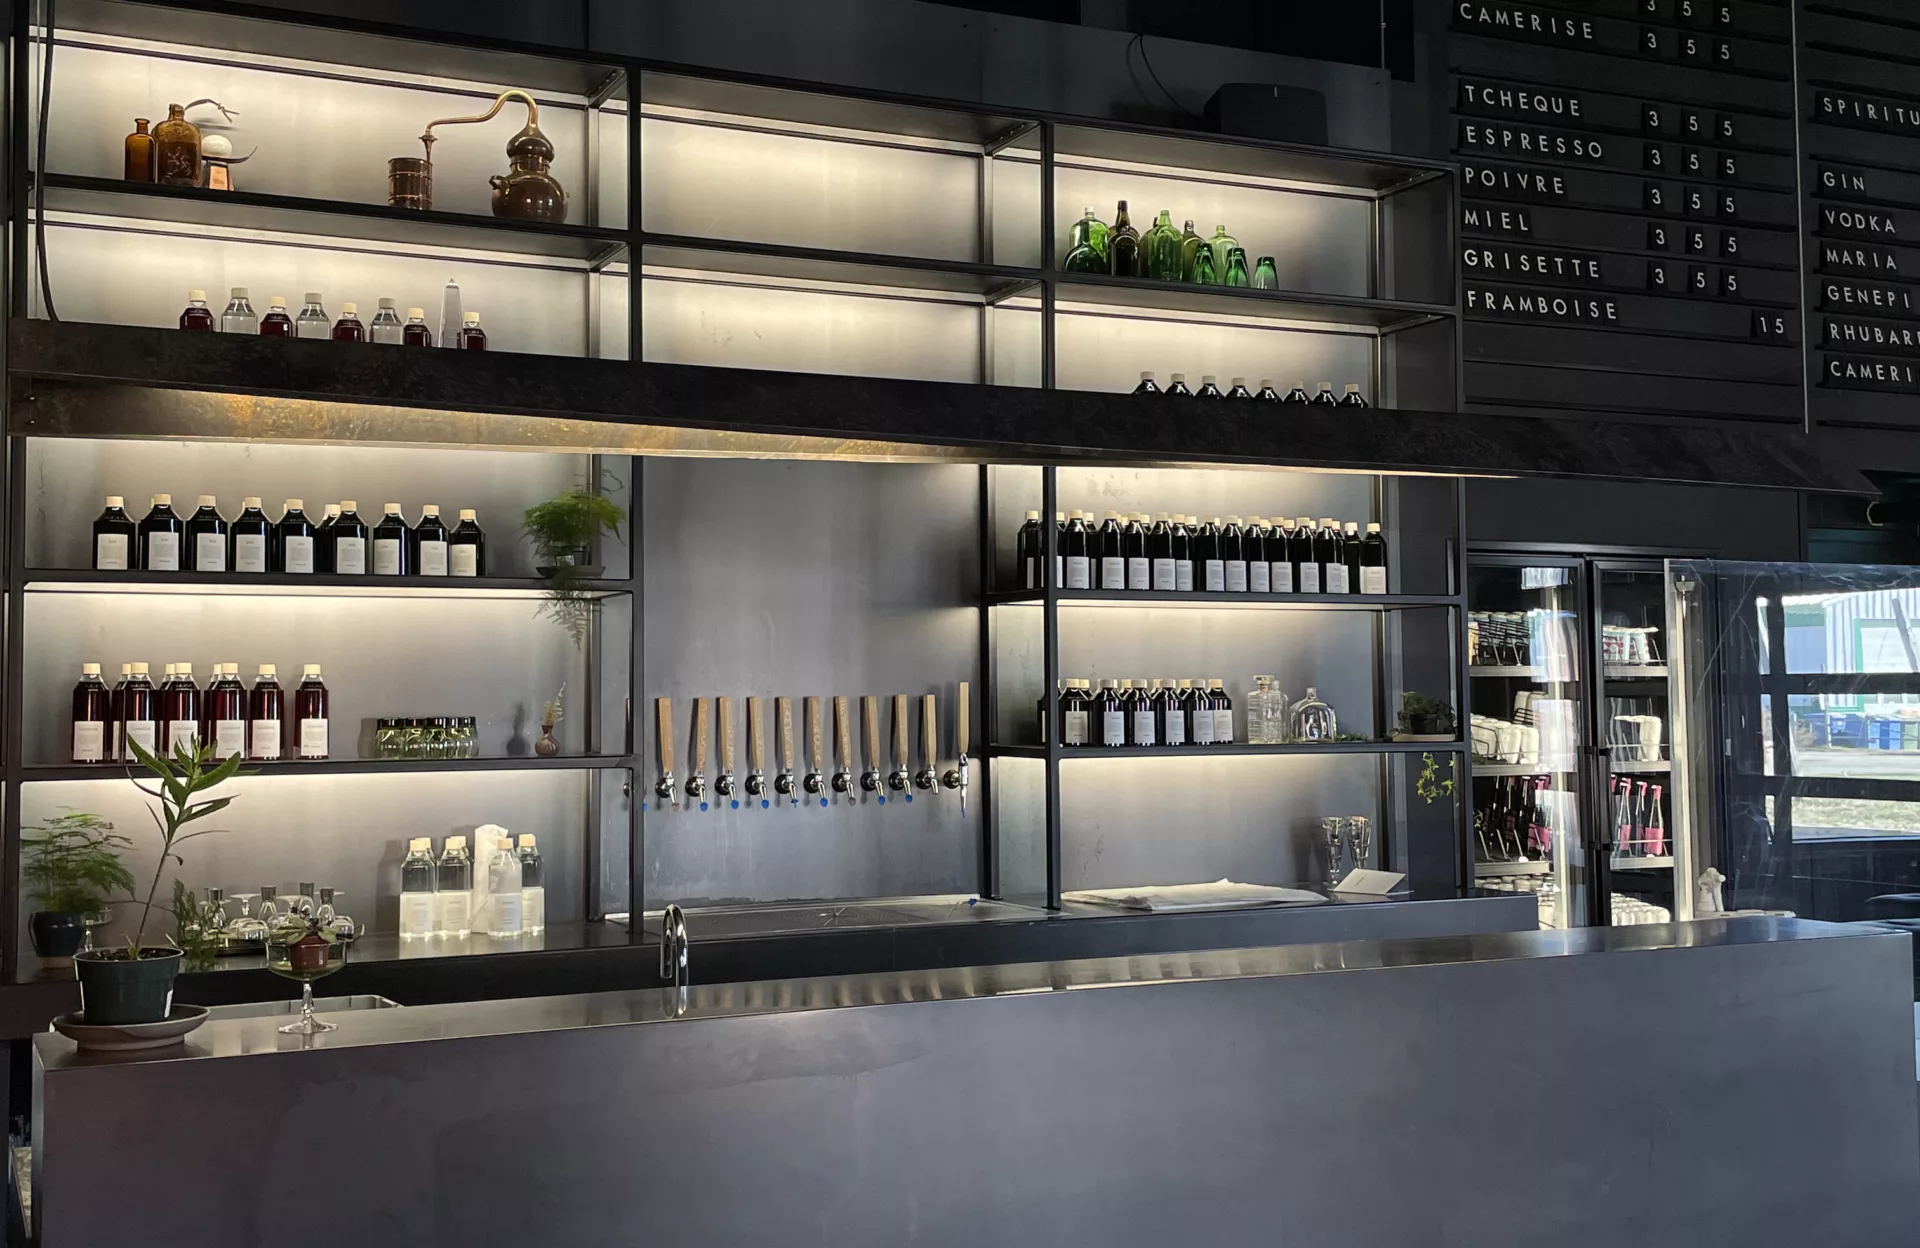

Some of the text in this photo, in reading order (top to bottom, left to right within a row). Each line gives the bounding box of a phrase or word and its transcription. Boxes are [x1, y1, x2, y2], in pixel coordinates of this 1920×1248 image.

[1460, 2, 1730, 60] CAMERISE 3 5 5
[1682, 0, 1692, 17] 5
[1721, 7, 1730, 23] 5
[1464, 84, 1733, 137] TCHEQUE 3 5 5
[1823, 97, 1920, 126] SPIRITU
[1465, 125, 1735, 174] ESPRESSO 3 5 5
[1464, 166, 1735, 213] POIVRE 3 5 5
[1823, 171, 1865, 191] GIN
[1464, 208, 1737, 253] MIEL 3 5 5
[1824, 209, 1896, 234] VODKA
[1463, 249, 1737, 291] GRISETTE 3 5 5
[1826, 248, 1897, 270] MARIA
[1467, 290, 1784, 334] FRAMBOISE 15
[1827, 285, 1910, 309] GENEPI
